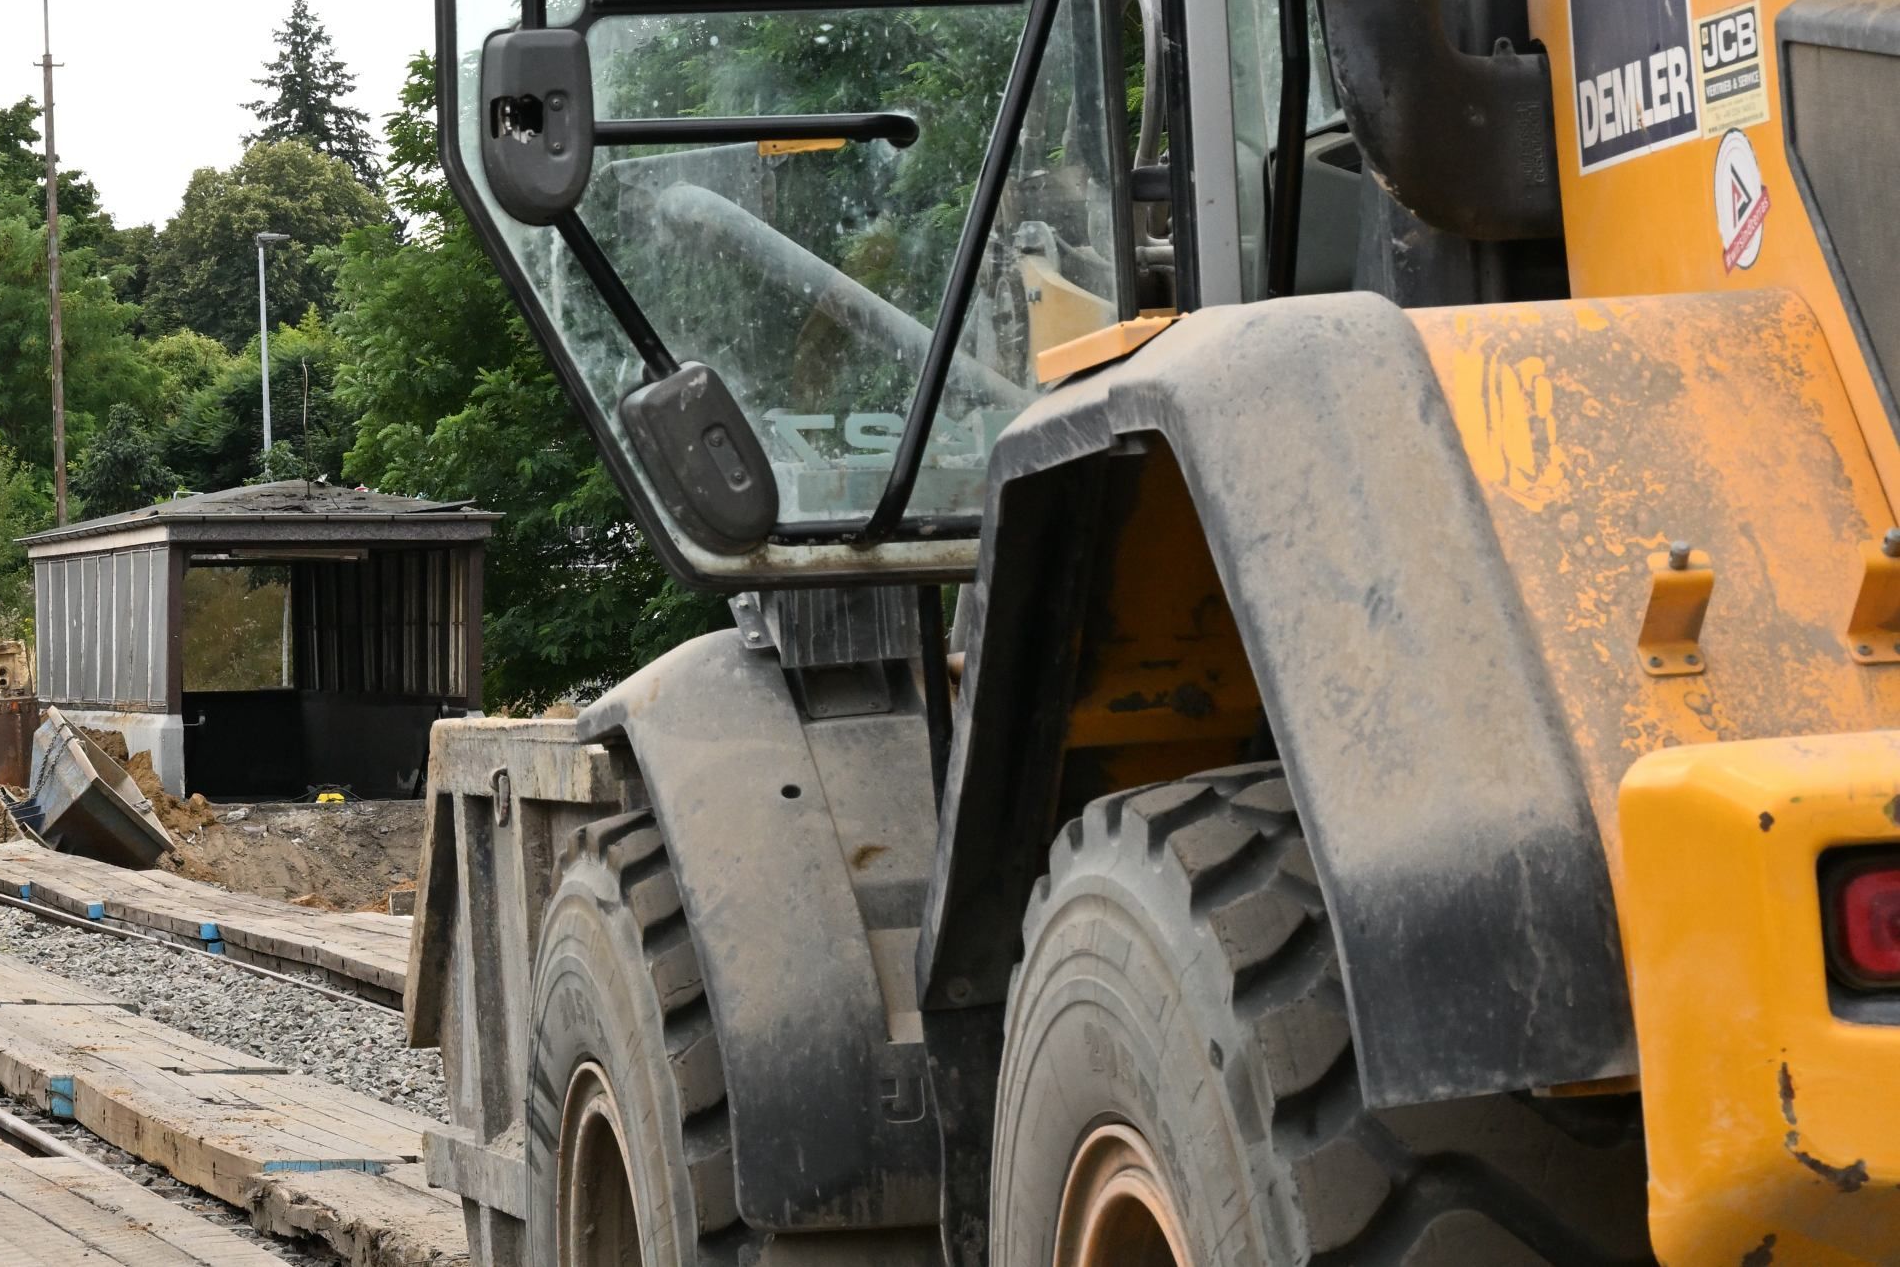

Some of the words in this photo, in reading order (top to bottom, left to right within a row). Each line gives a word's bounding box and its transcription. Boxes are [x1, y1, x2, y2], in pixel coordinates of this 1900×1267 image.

[1702, 12, 1757, 68] JCB
[1579, 46, 1692, 149] DEMLER
[1706, 79, 1732, 98] VERTRIEB
[1738, 70, 1760, 89] SERVICE
